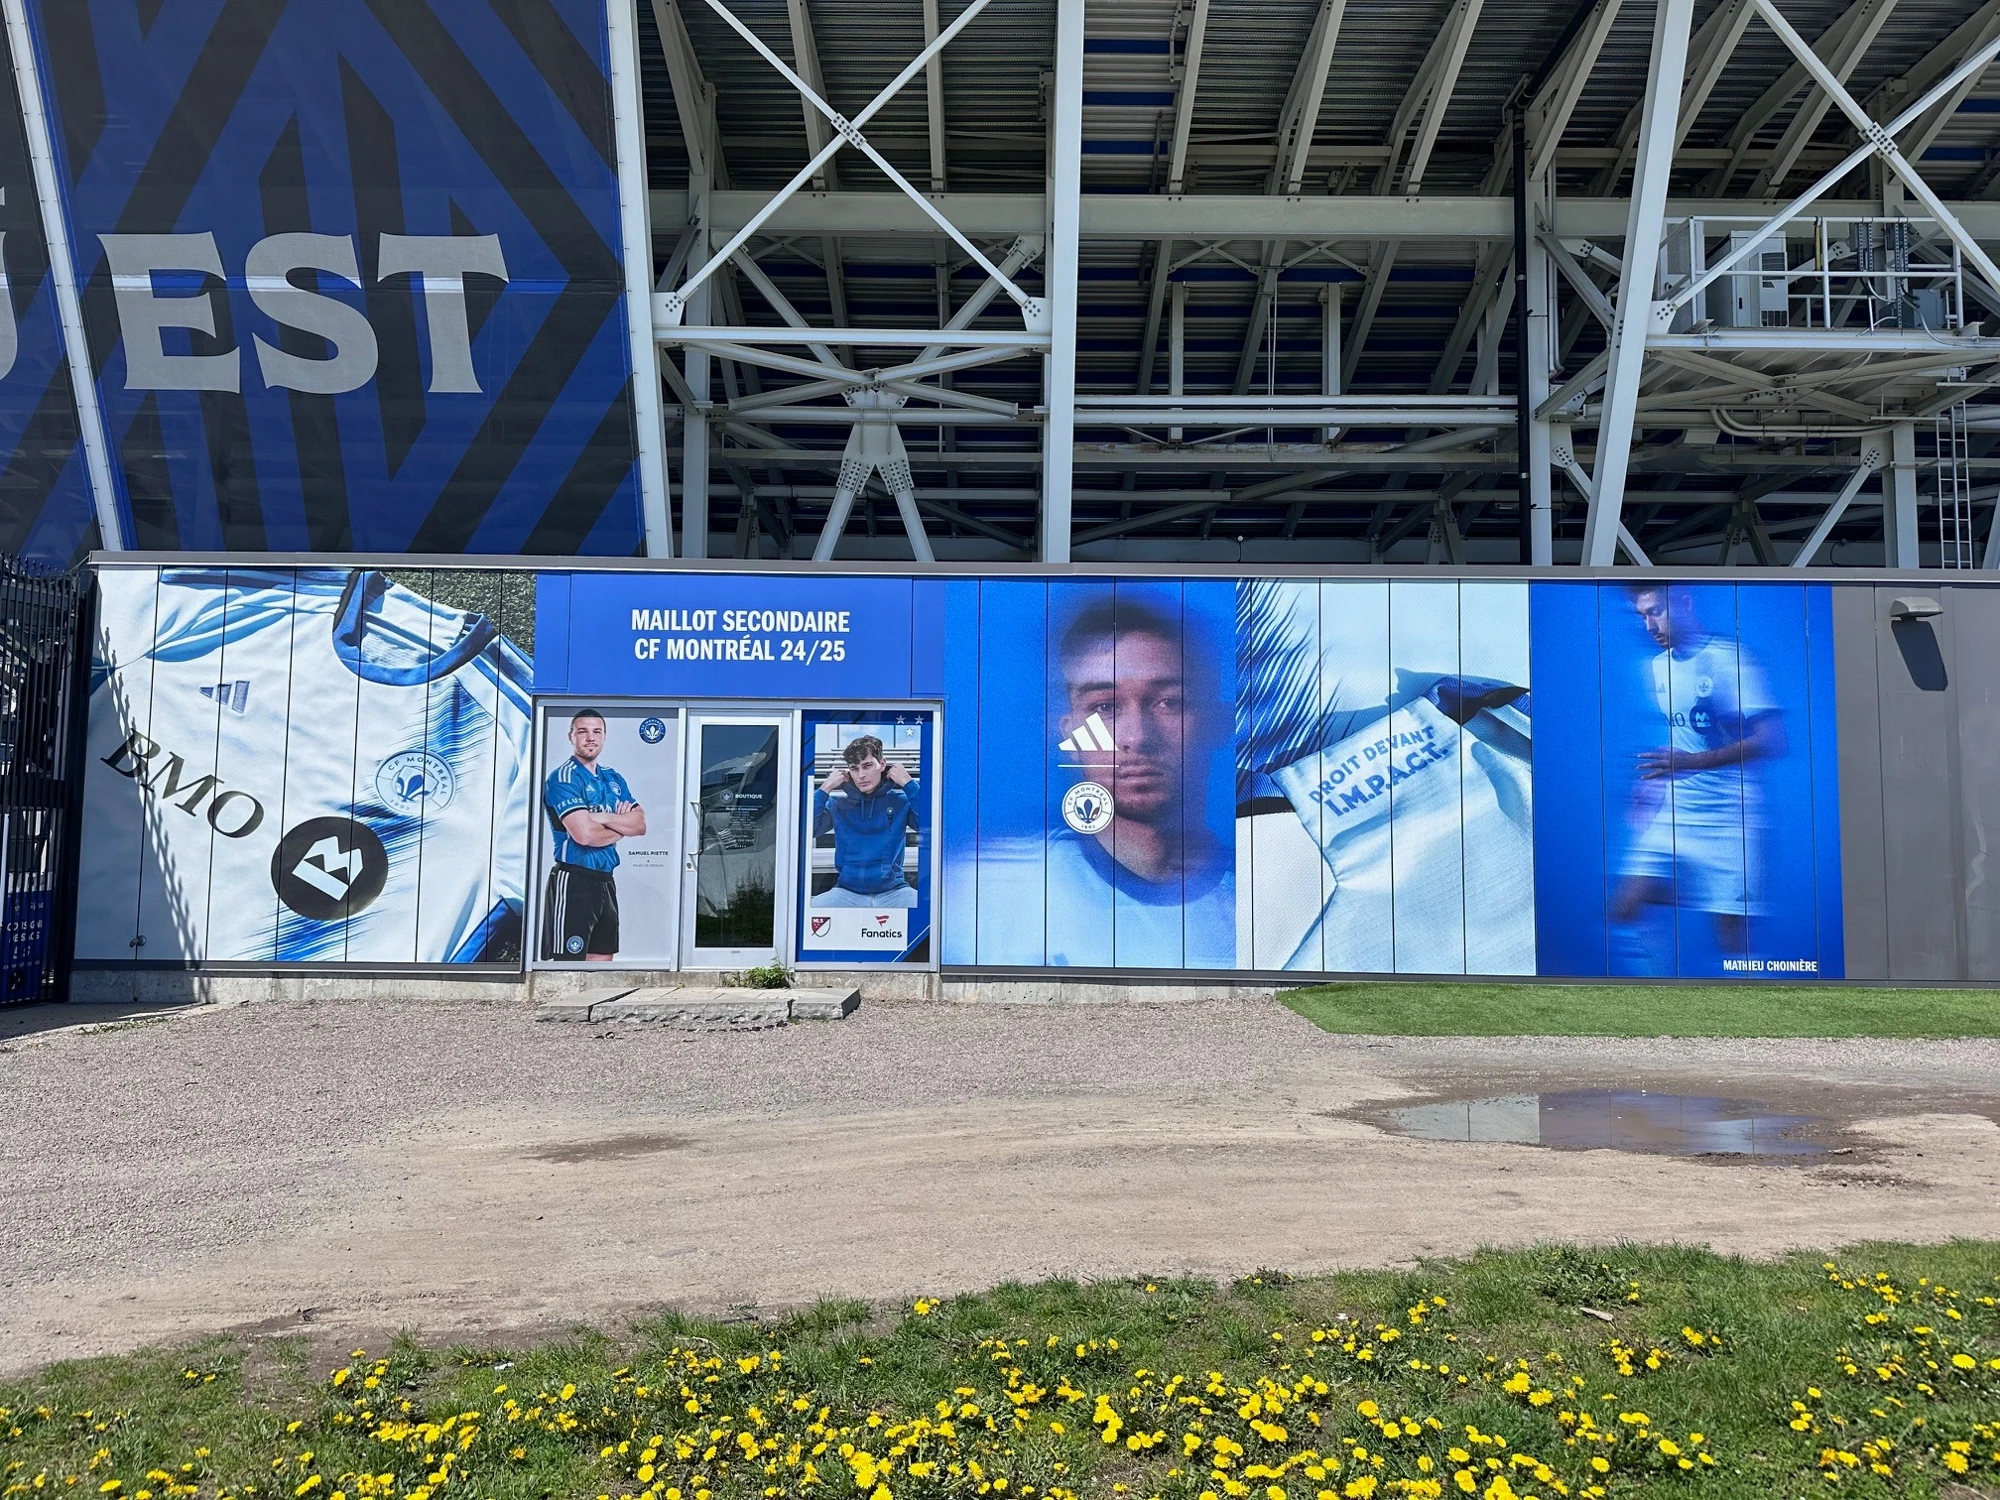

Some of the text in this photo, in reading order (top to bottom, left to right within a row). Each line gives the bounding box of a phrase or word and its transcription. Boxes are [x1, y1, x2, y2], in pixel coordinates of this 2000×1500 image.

[97, 231, 509, 394] EST
[631, 609, 850, 633] MAILLOT SECONDAIRE
[634, 634, 845, 666] CF MONTRÉAL 24/25
[388, 759, 401, 771] CF
[1308, 725, 1437, 804] DROIT DEVANT
[100, 727, 264, 838] BMO
[1324, 741, 1449, 817] I.M.P.A.C.T.
[557, 797, 584, 810] TELUS
[861, 928, 903, 938] Fanatics
[1723, 958, 1818, 972] MATHIEU CHOINIÈRE
